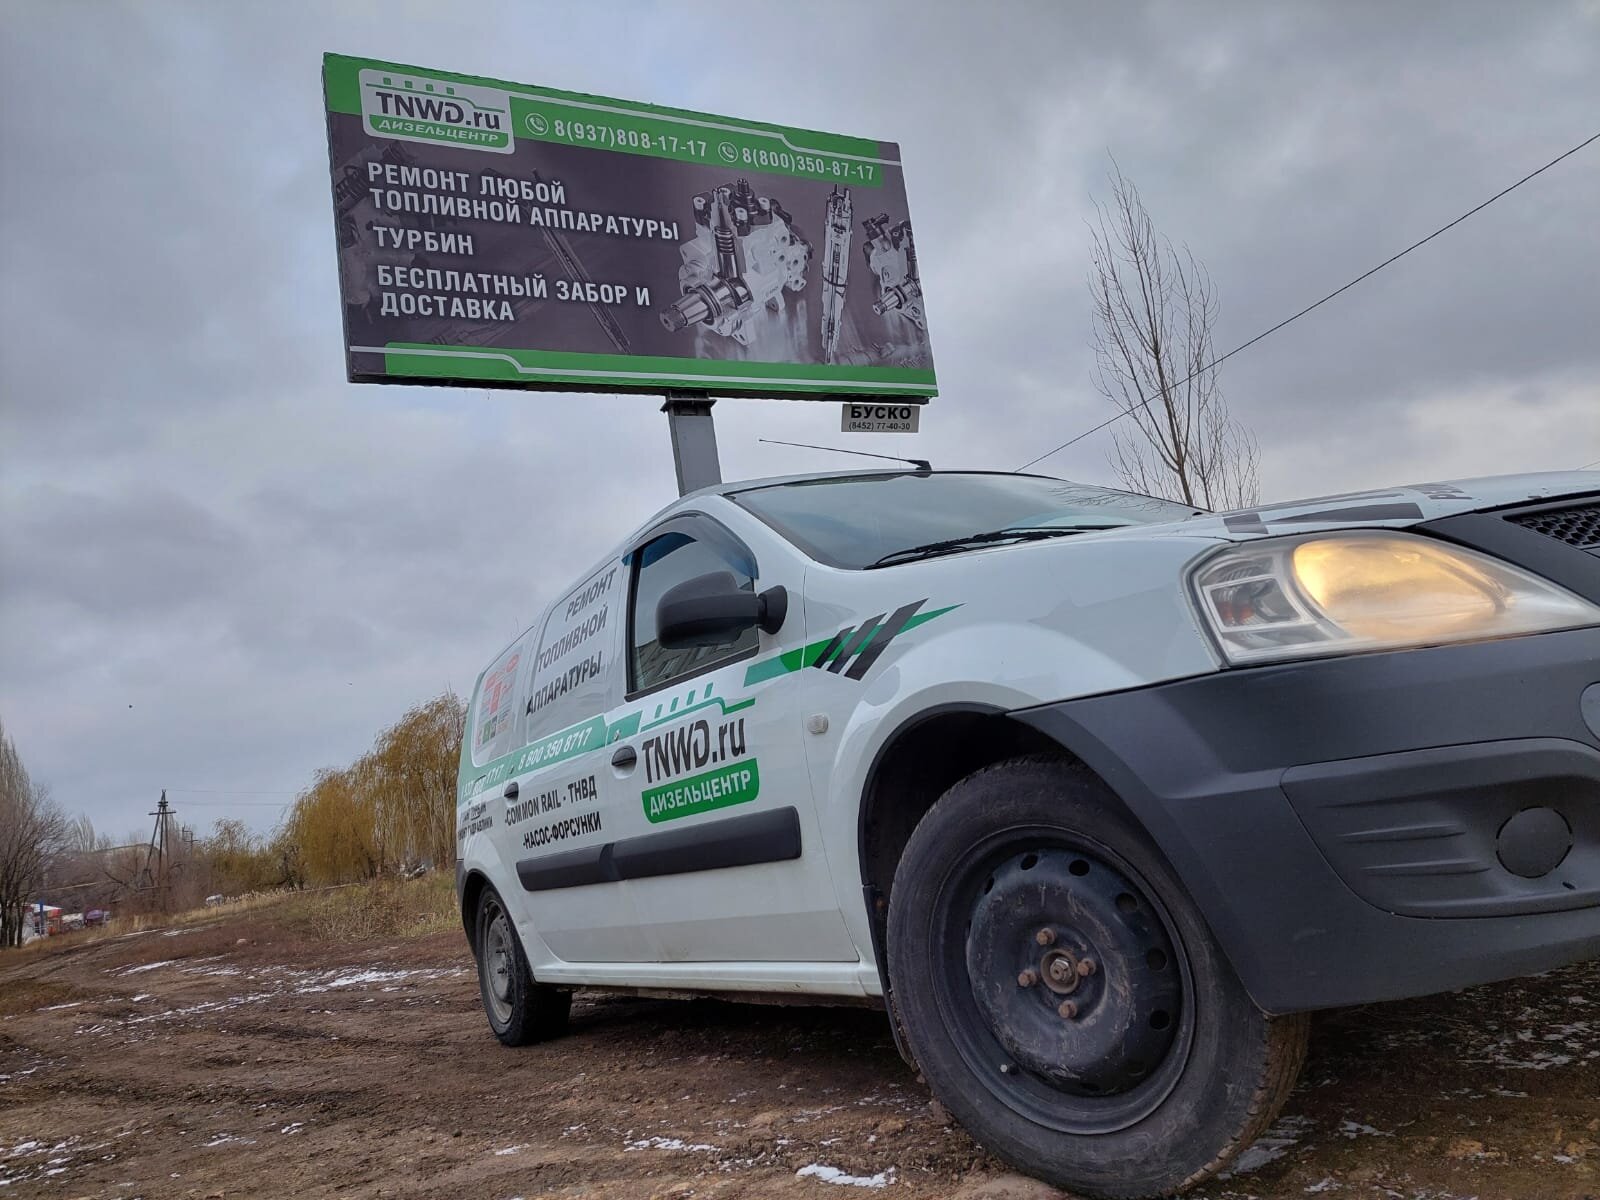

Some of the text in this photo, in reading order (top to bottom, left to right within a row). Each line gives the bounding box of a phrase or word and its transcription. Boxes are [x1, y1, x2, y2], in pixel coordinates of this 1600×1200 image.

[375, 91, 500, 130] TNWD.ru
[378, 119, 499, 142] ДИЗЕЛЬЦЕНТР
[554, 119, 707, 157] 8(937)808-17-17
[367, 161, 567, 205] РЕМОНТ ЛЮБОЙ
[742, 147, 874, 181] 8(800)350-87-17
[369, 188, 680, 241] ТОПЛИВНОЙ АППАРАТУРЫ
[373, 226, 474, 255] ТУРБИН
[377, 265, 651, 306] БЕСПЛАТНЫЙ ЗАБОР И
[381, 292, 516, 321] ДОСТАВКА
[848, 421, 911, 431] (8452) 77-40-30
[850, 406, 912, 420] БУСКО
[565, 567, 617, 622] РЕМОНТ
[538, 601, 609, 673] ТОПЛИВНОЙ
[525, 650, 602, 717] АППАРАТУРЫ
[544, 738, 563, 761] 350
[563, 727, 593, 753] 8717
[641, 717, 746, 784] TNWD.ru
[541, 789, 562, 813] RAIL
[567, 775, 598, 804] ТНВД
[650, 769, 751, 817] ДИЗЕЛЬЦЕНТР
